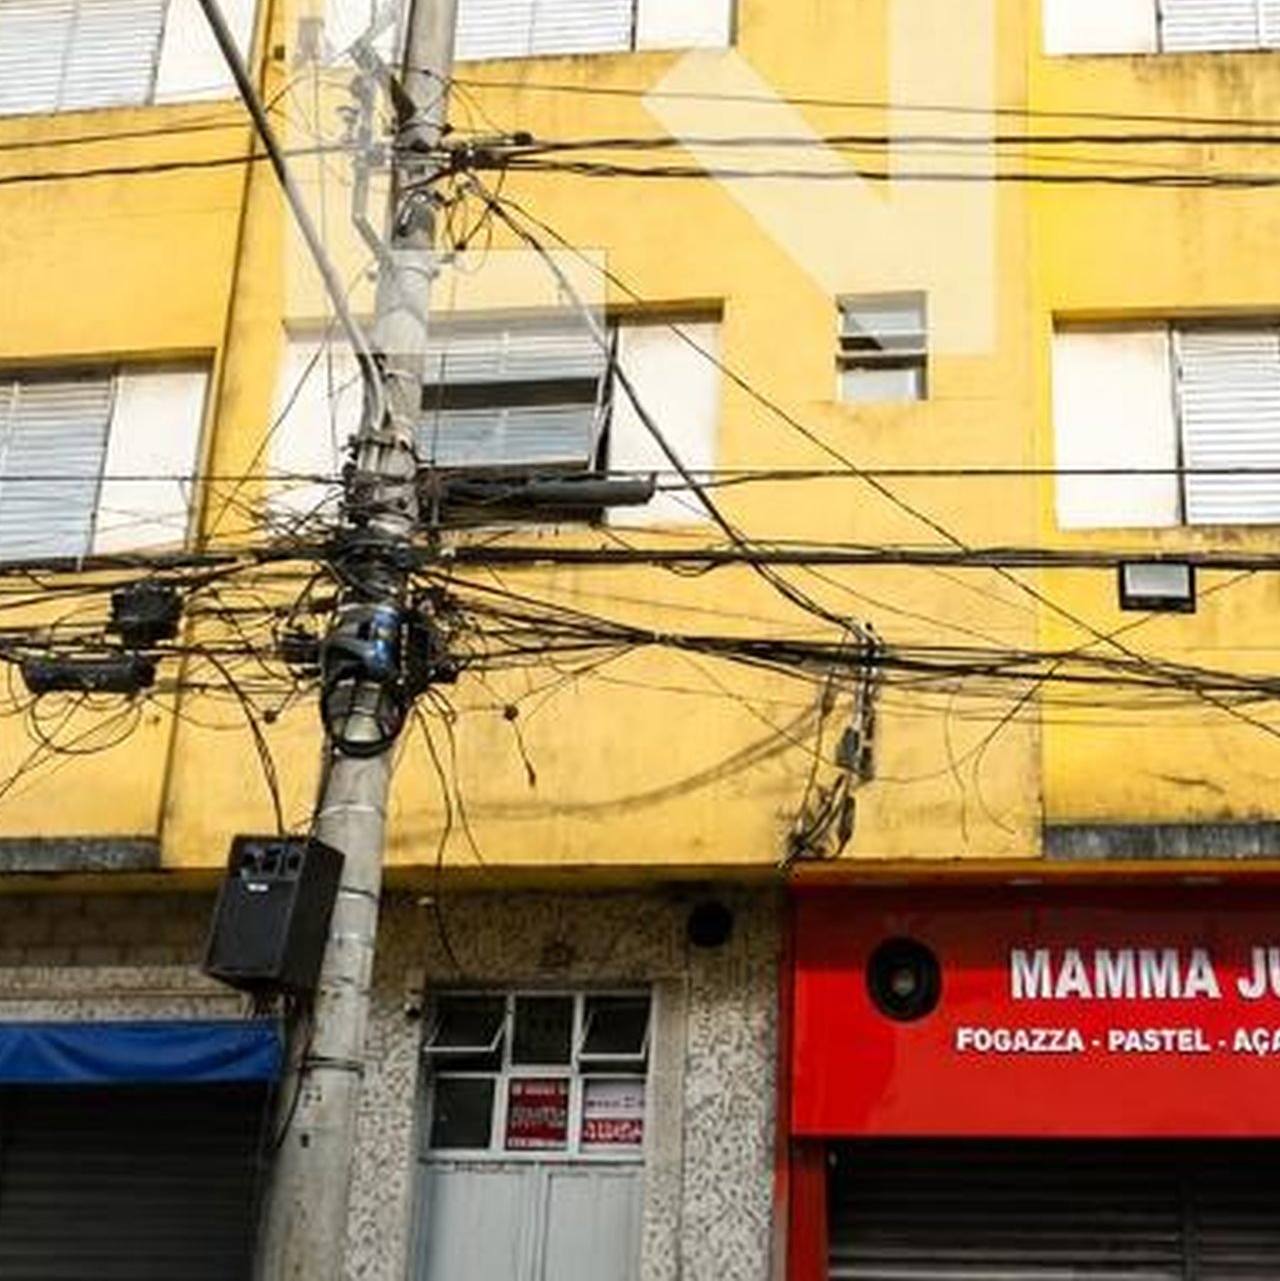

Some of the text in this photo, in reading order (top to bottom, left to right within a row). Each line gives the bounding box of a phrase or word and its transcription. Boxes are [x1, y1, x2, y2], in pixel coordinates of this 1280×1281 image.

[1011, 948, 1222, 999] MAMMA
[956, 1027, 1085, 1052] FOGAZZA
[1108, 1027, 1211, 1052] PASTEL
